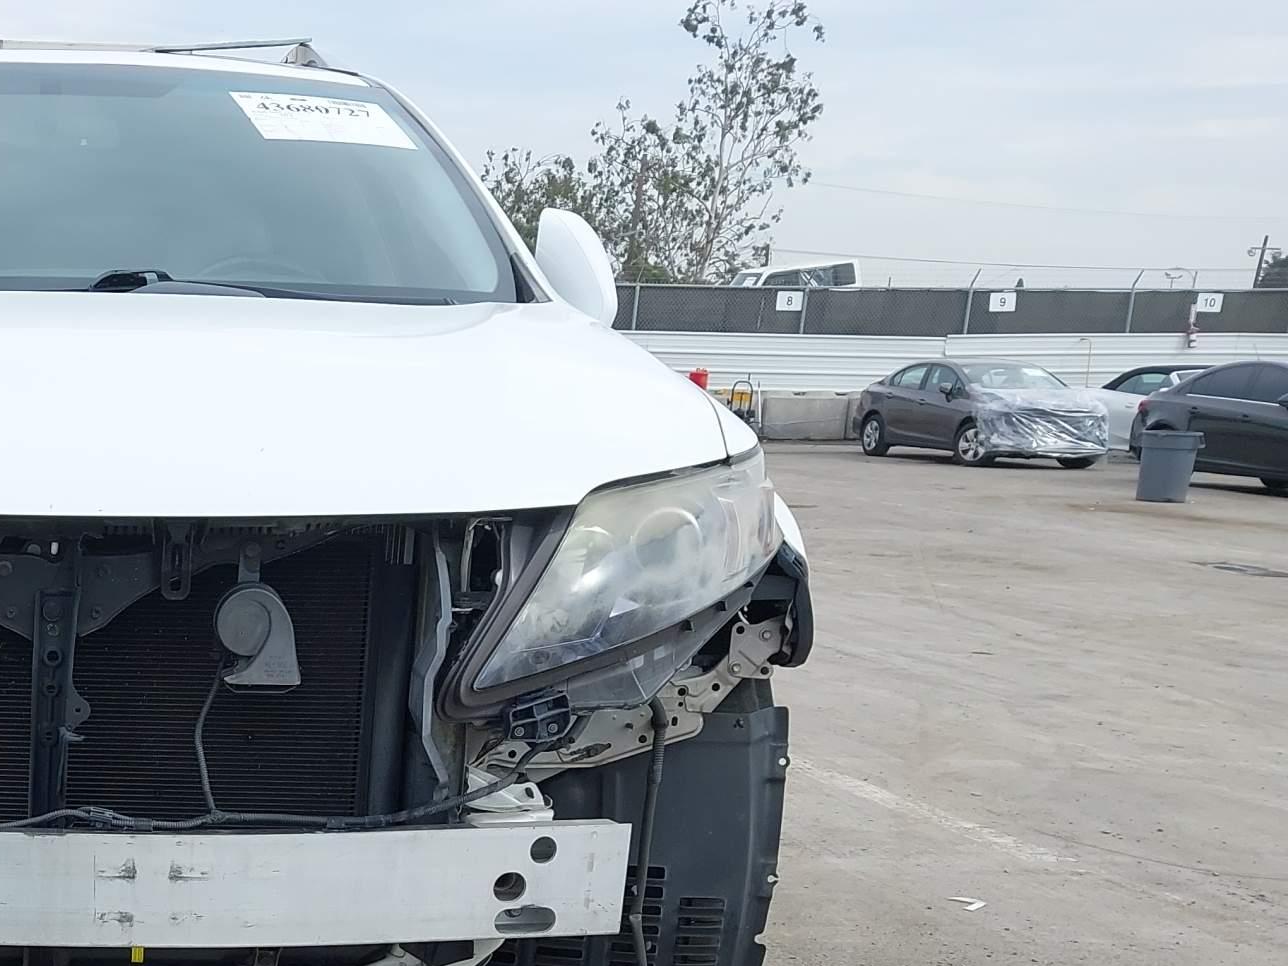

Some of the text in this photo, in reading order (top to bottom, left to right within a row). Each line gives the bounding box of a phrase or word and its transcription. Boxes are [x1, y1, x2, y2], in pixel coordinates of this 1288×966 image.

[255, 101, 371, 118] 43680727
[787, 296, 793, 306] 8
[999, 297, 1007, 307] 9
[1205, 297, 1216, 308] 10
